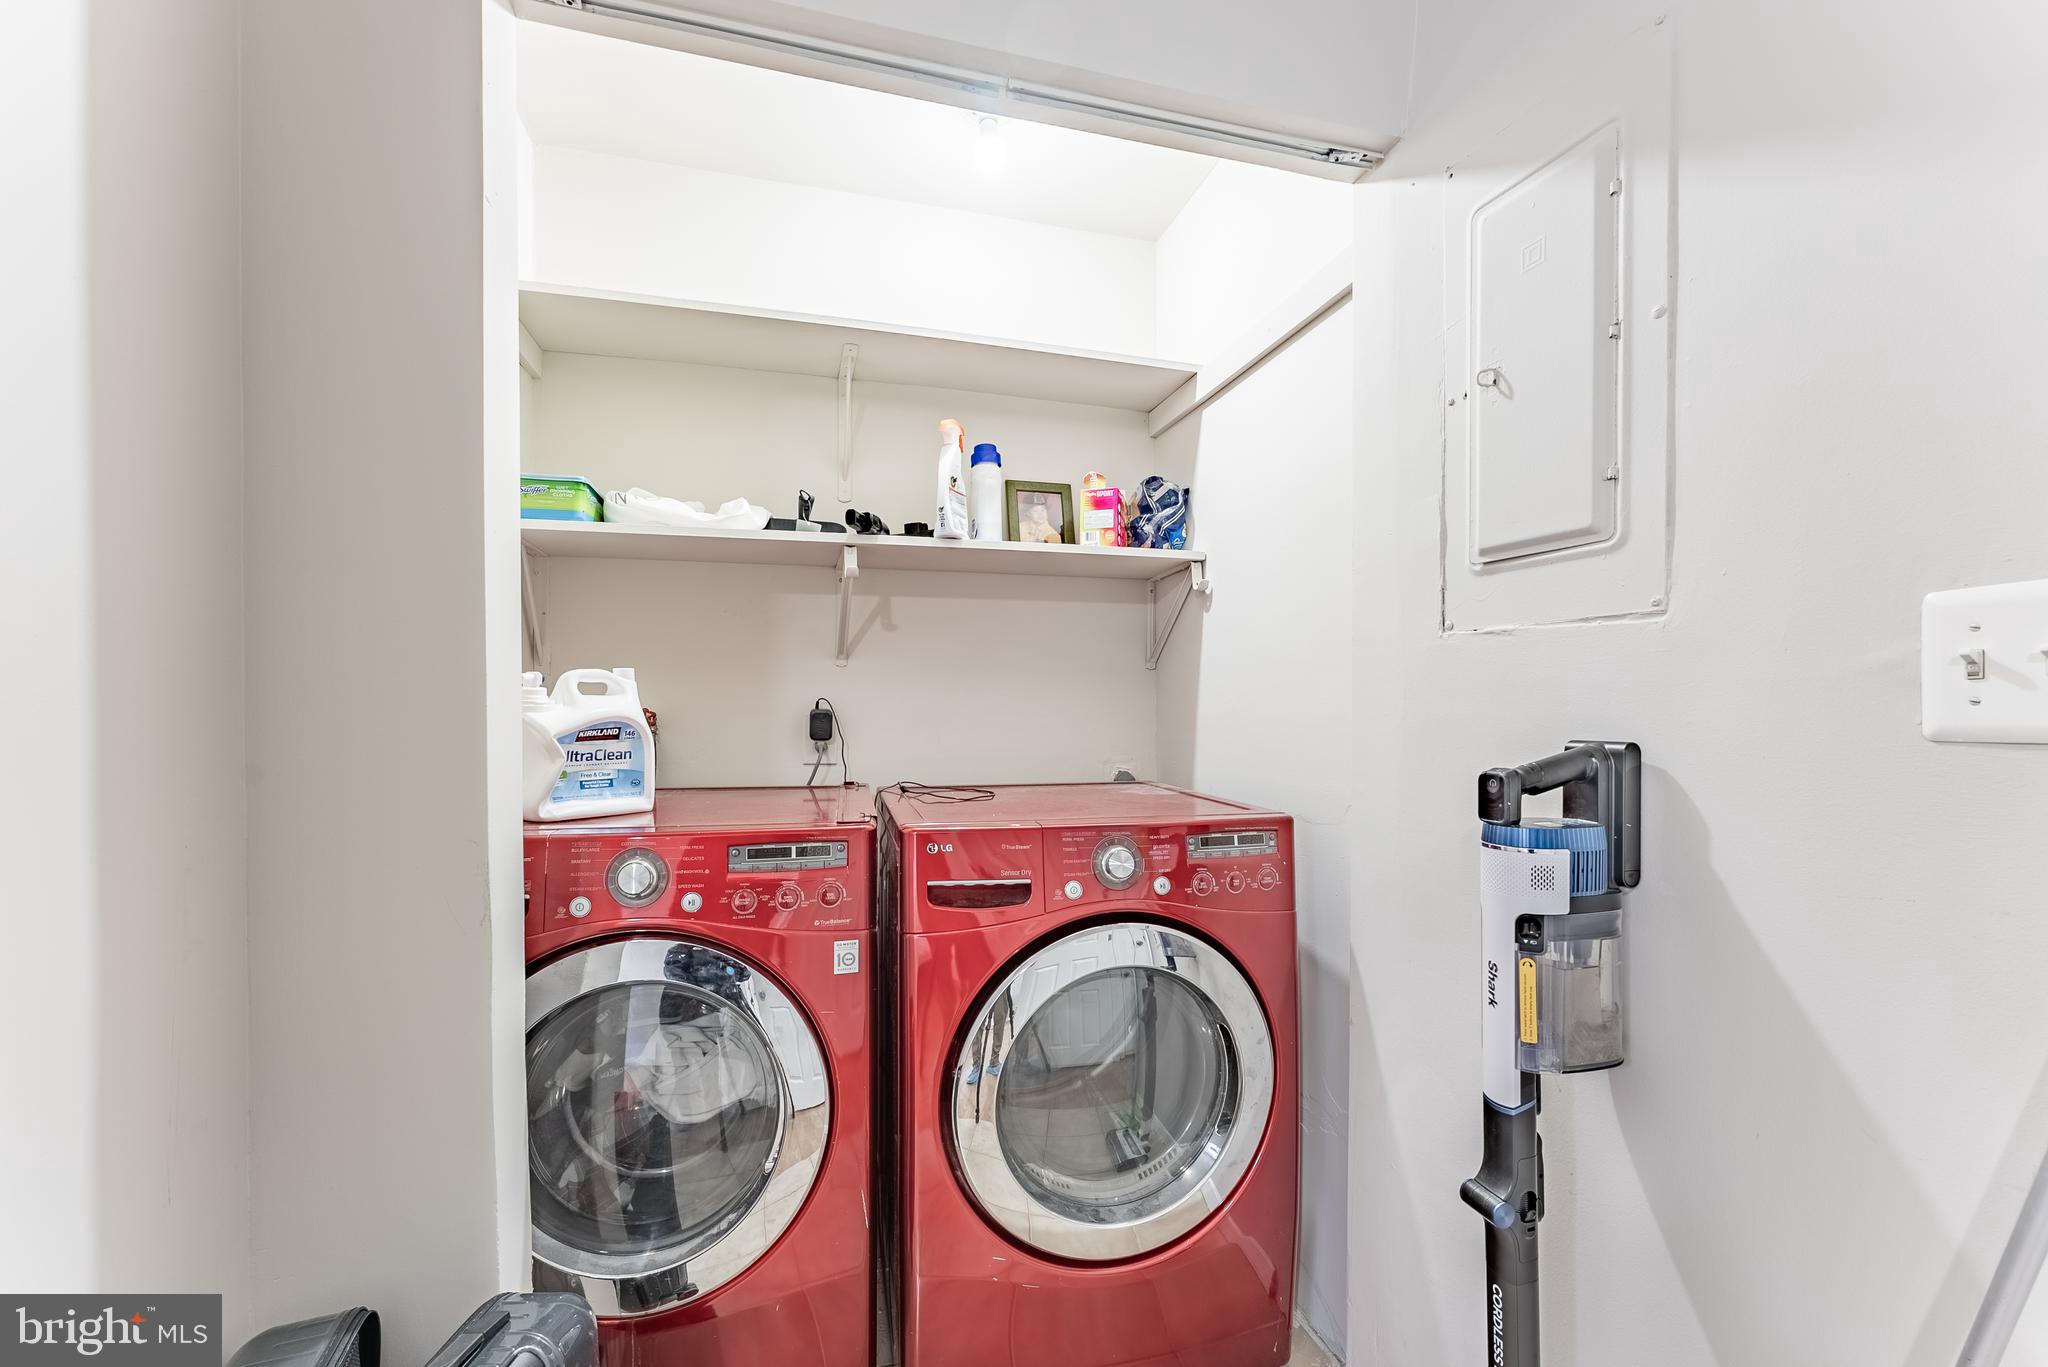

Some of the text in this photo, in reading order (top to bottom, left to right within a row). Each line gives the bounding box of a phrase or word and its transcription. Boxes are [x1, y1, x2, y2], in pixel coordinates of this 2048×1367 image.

[578, 728, 620, 738] KIRKLAND
[940, 844, 953, 852] LG
[1021, 869, 1031, 877] Dry
[1488, 960, 1498, 1009] Shark
[1492, 1284, 1504, 1366] CORDLESS
